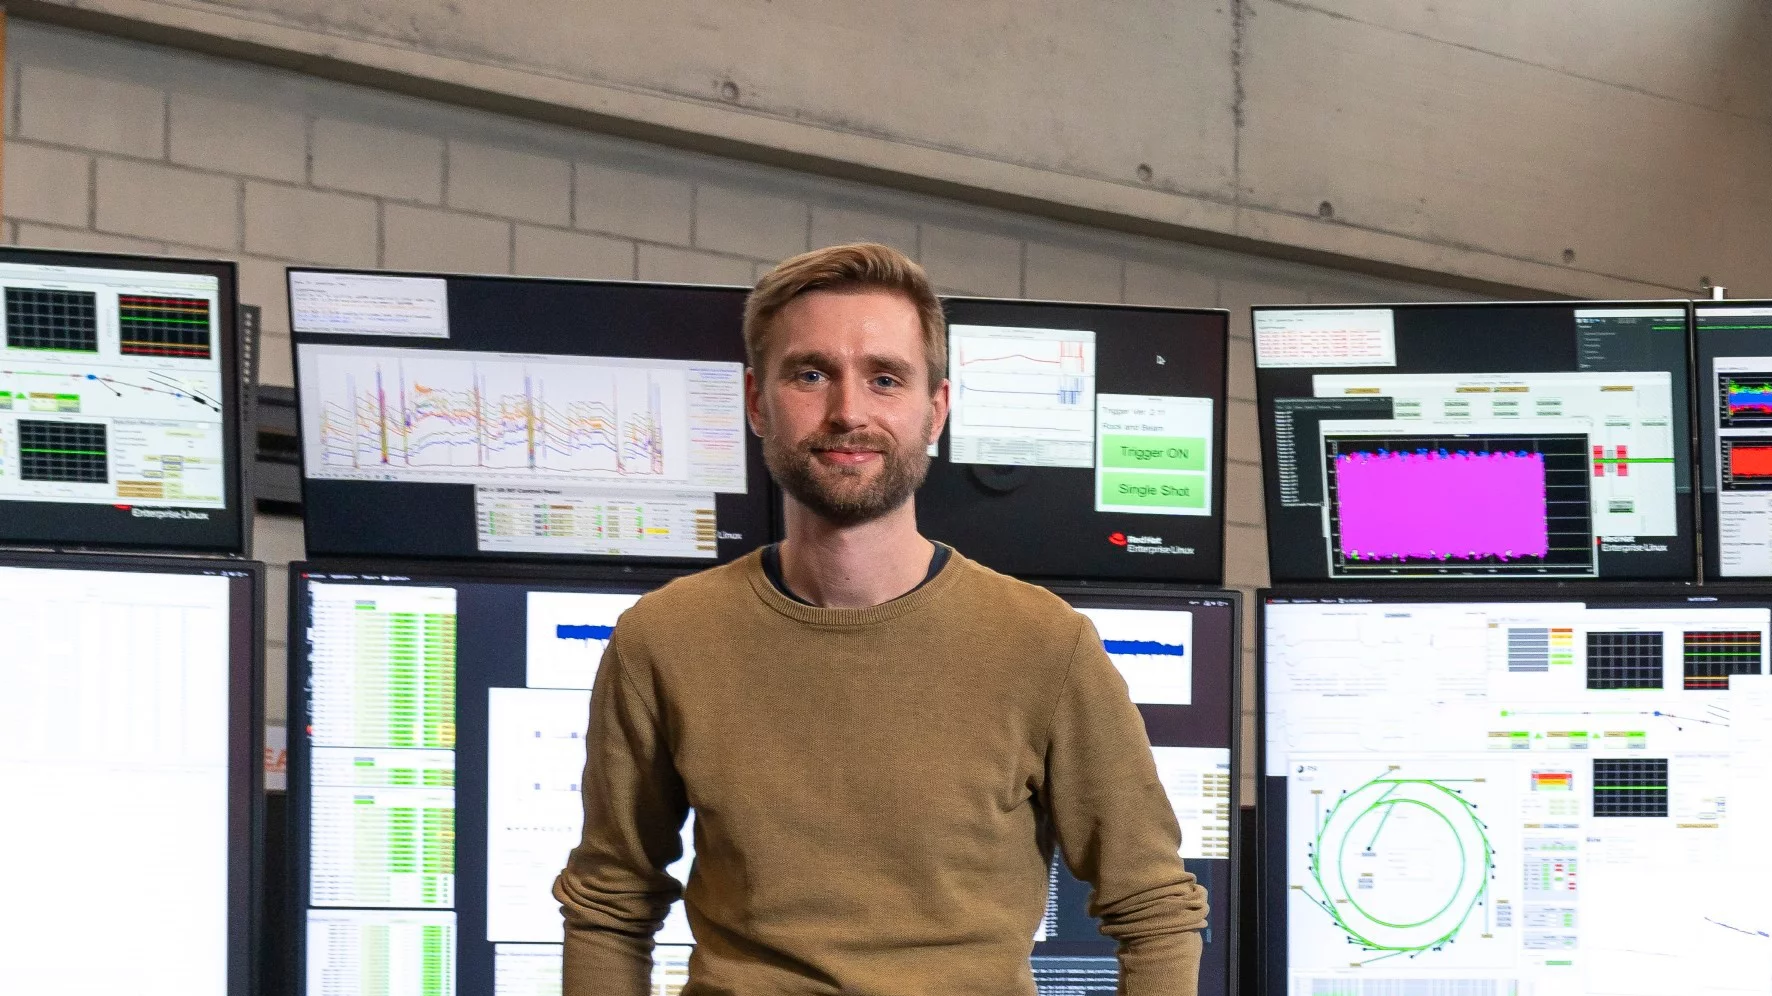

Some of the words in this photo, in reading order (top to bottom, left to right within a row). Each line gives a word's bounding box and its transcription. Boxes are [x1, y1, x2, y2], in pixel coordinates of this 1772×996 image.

[1120, 445, 1163, 460] Trigger
[1167, 447, 1189, 459] ON
[1118, 483, 1157, 498] Single
[1161, 485, 1190, 497] Shot
[1170, 545, 1195, 555] Linux
[1643, 543, 1668, 552] Linux
